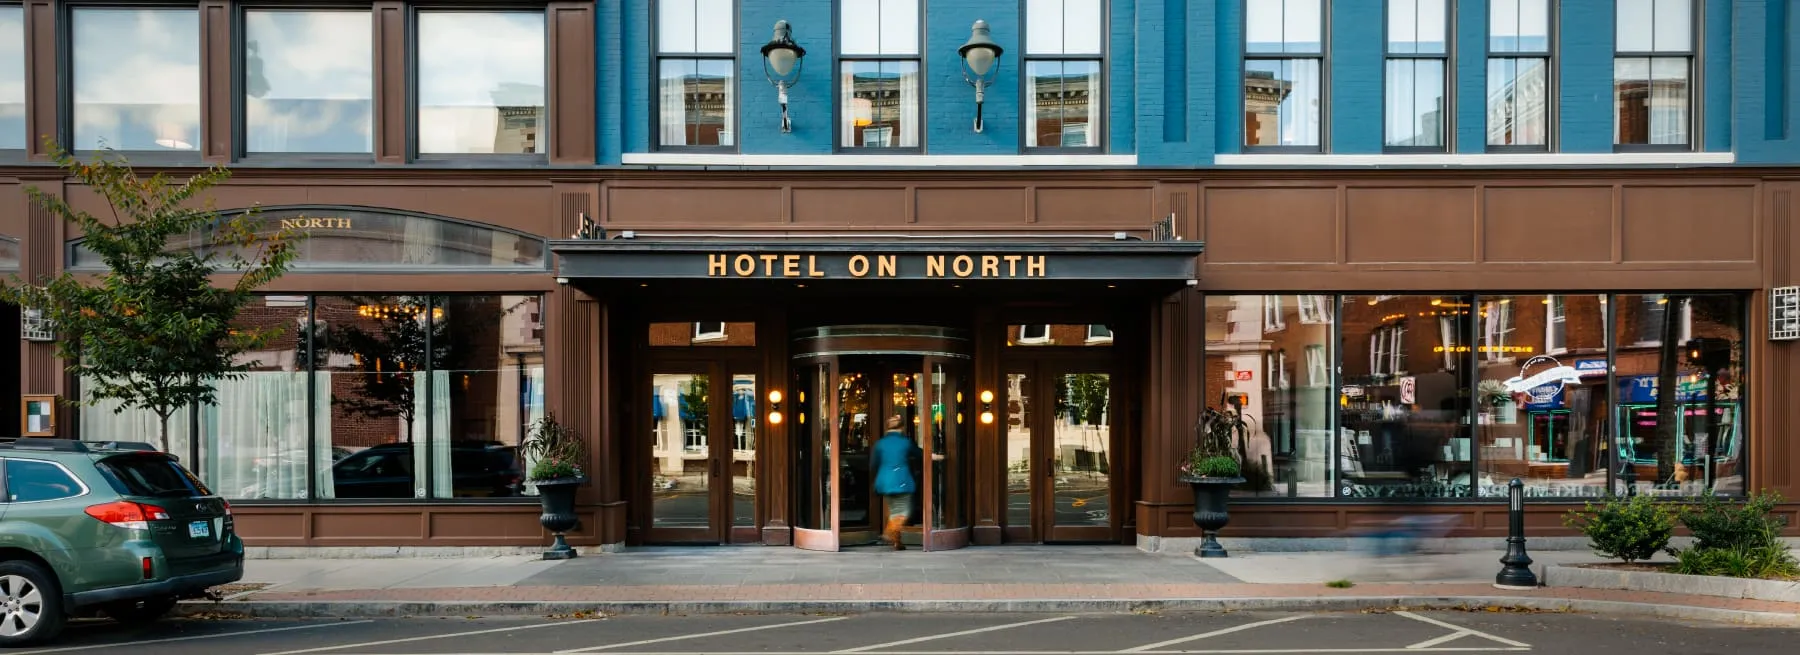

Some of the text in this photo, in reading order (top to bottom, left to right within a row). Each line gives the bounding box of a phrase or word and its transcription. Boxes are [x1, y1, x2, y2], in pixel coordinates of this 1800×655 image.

[281, 217, 351, 228] NORTH
[708, 254, 1047, 278] HOTEL ON NORTH
